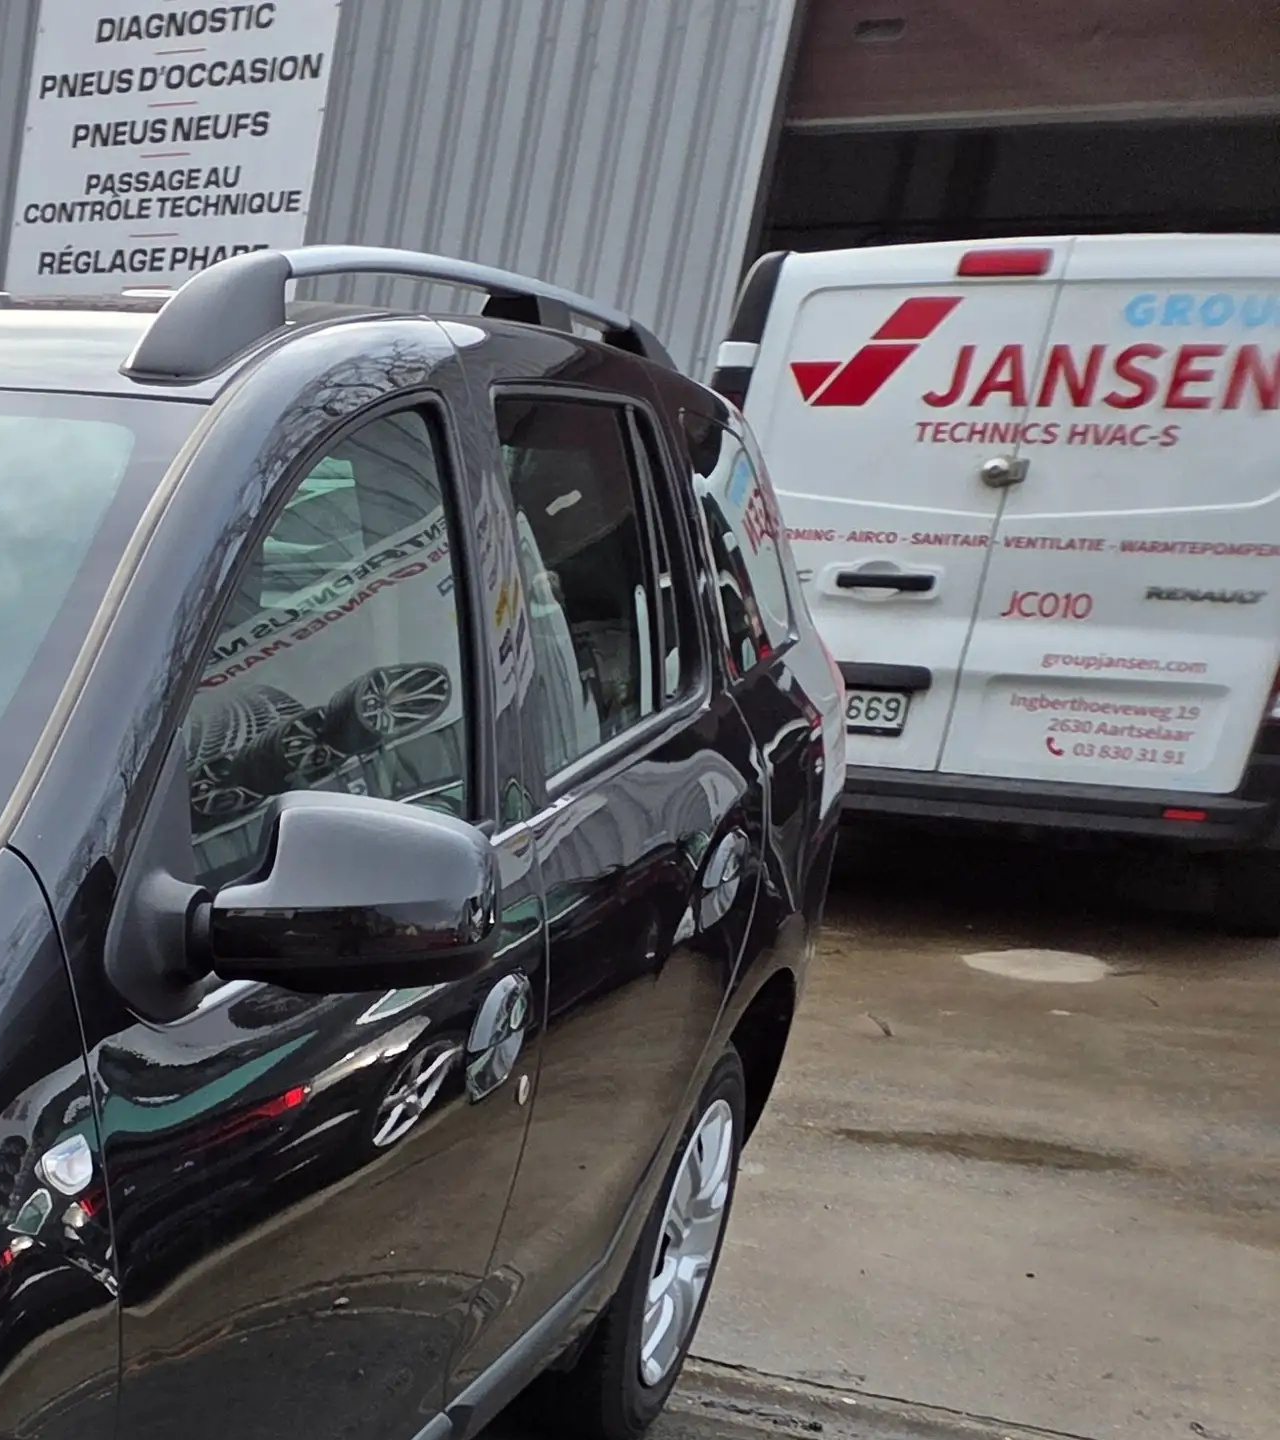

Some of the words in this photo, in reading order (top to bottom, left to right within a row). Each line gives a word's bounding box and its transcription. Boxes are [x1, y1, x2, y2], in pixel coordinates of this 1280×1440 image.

[95, 2, 276, 43] DIAGNOSTIC
[40, 67, 134, 100] PNEUS
[138, 52, 325, 92] D'OCCASION
[72, 118, 167, 148] PNEUS
[171, 111, 271, 142] NEUFS
[85, 168, 202, 195] PASSAGE
[203, 165, 242, 190] AU
[23, 193, 154, 224] CONTRÔLE
[157, 190, 302, 218] TECHNIQUE
[38, 244, 167, 275] RÉGLAGE
[921, 343, 1280, 410] JANSEN
[916, 421, 1060, 445] TECHNICS
[1066, 423, 1182, 448] HVAC-S
[846, 531, 898, 545] AIRCO
[911, 532, 990, 547] SANITAIR
[1003, 535, 1106, 552] VENTILATIE
[1145, 586, 1268, 604] RENAULT
[1042, 652, 1207, 674] groupjansen.com
[845, 696, 901, 722] 669
[1010, 693, 1171, 721] Ingberthoeveweg
[1176, 706, 1201, 721] 19
[1047, 718, 1091, 734] 2630
[1095, 721, 1195, 742] Aartselaar
[1073, 742, 1094, 757] 03
[1097, 744, 1133, 760] 830
[1137, 747, 1157, 762] 31
[1162, 749, 1185, 764] 91
